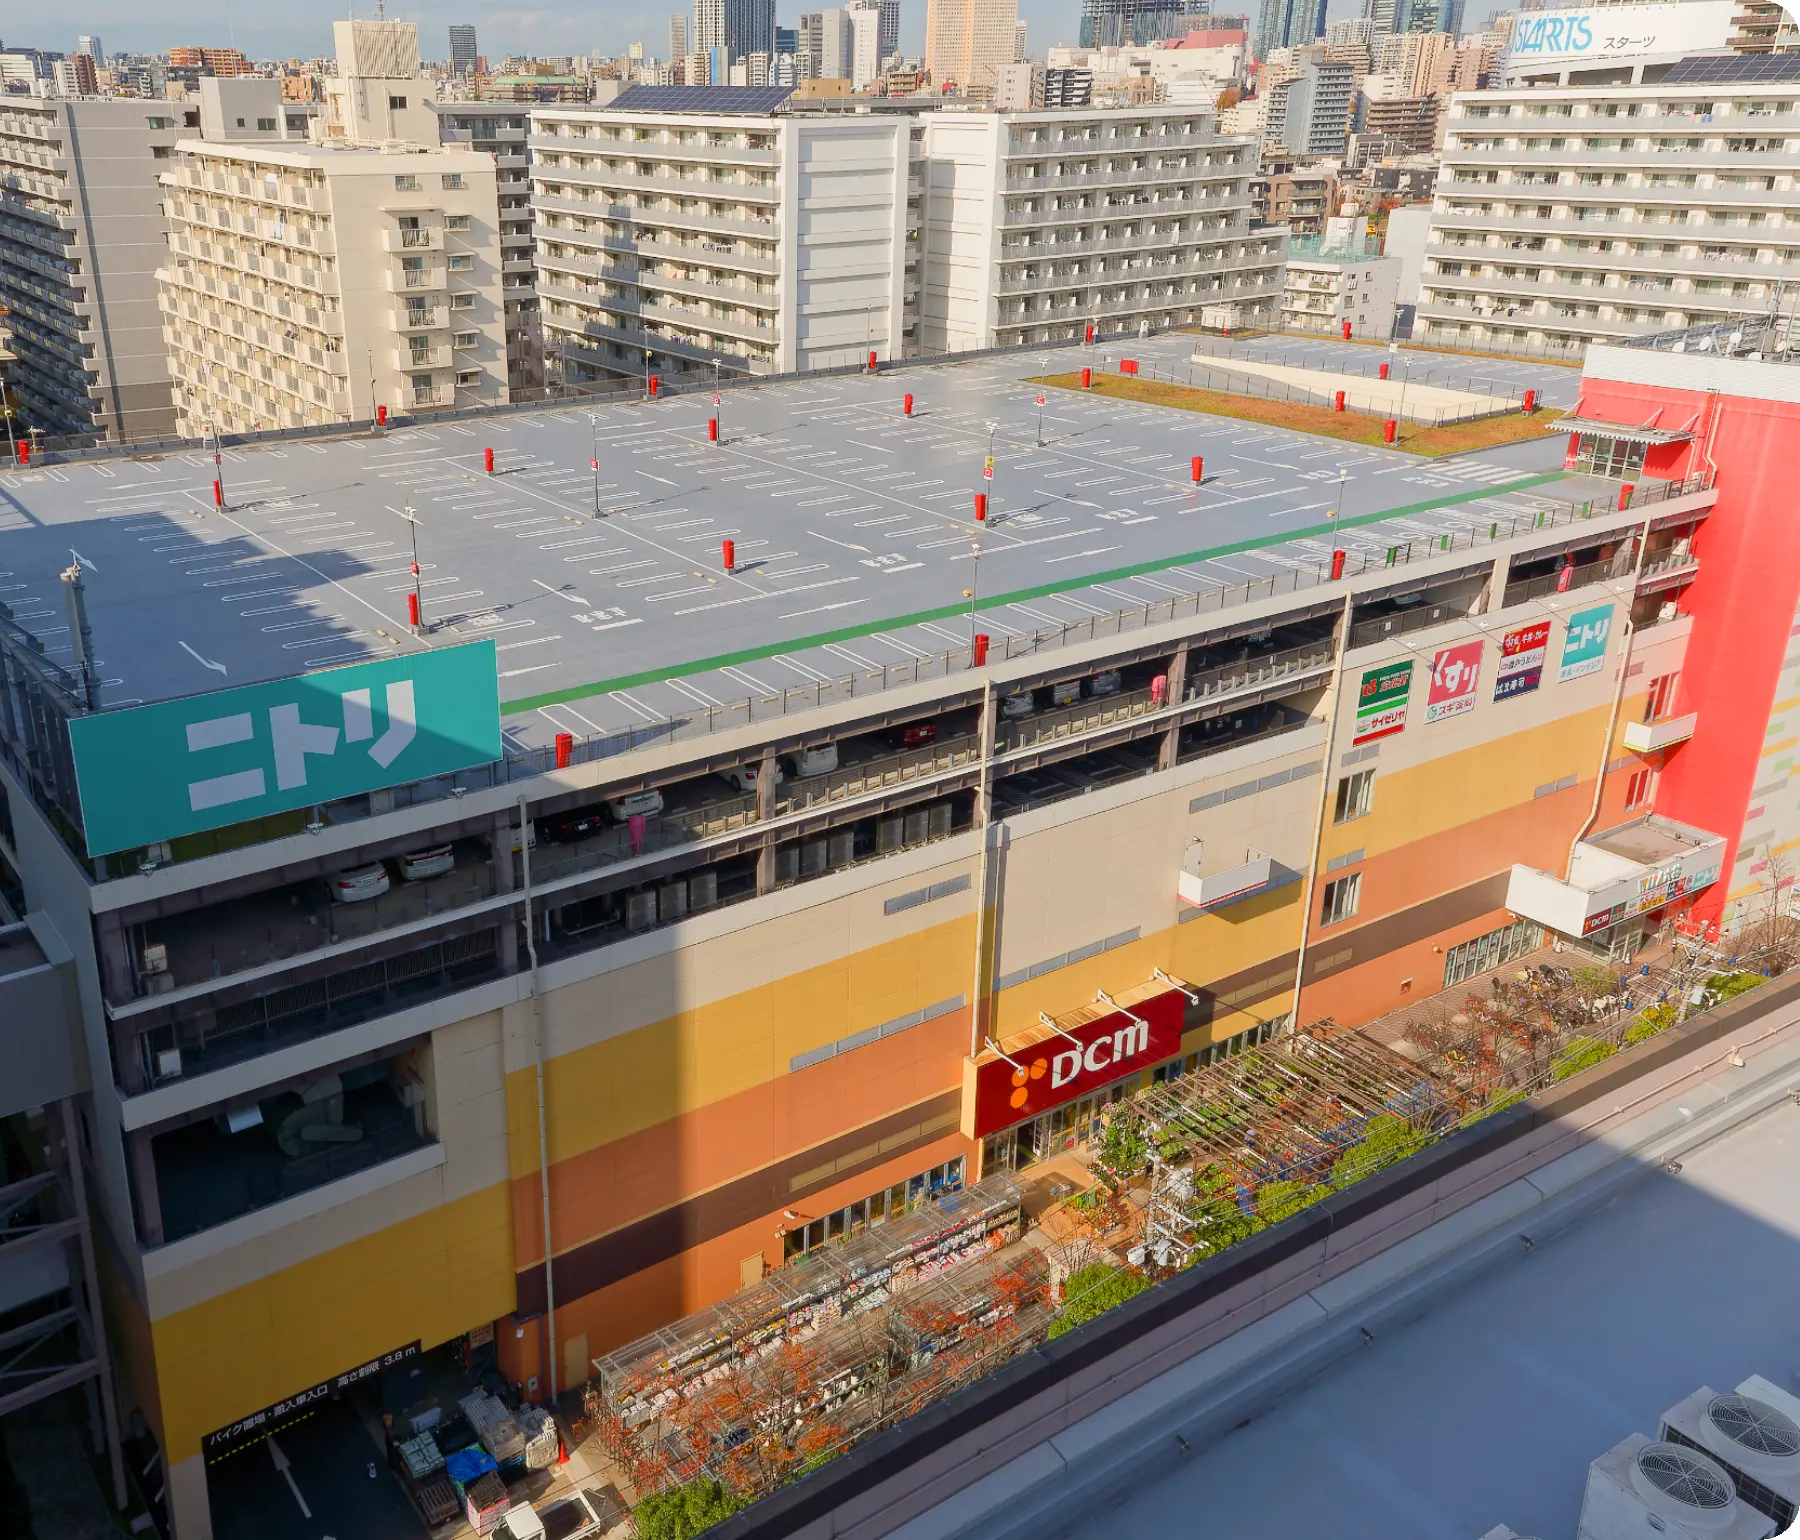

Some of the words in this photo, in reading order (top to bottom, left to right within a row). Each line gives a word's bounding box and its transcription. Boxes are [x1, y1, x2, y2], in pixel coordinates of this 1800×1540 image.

[1603, 36, 1656, 49] スターツ
[1565, 618, 1610, 653] ニトリ
[1433, 651, 1478, 693] くすり
[1371, 711, 1405, 728] サイゼリヤ
[186, 680, 416, 811] ニトリ
[384, 1351, 403, 1367] 3.8
[405, 1346, 416, 1357] m
